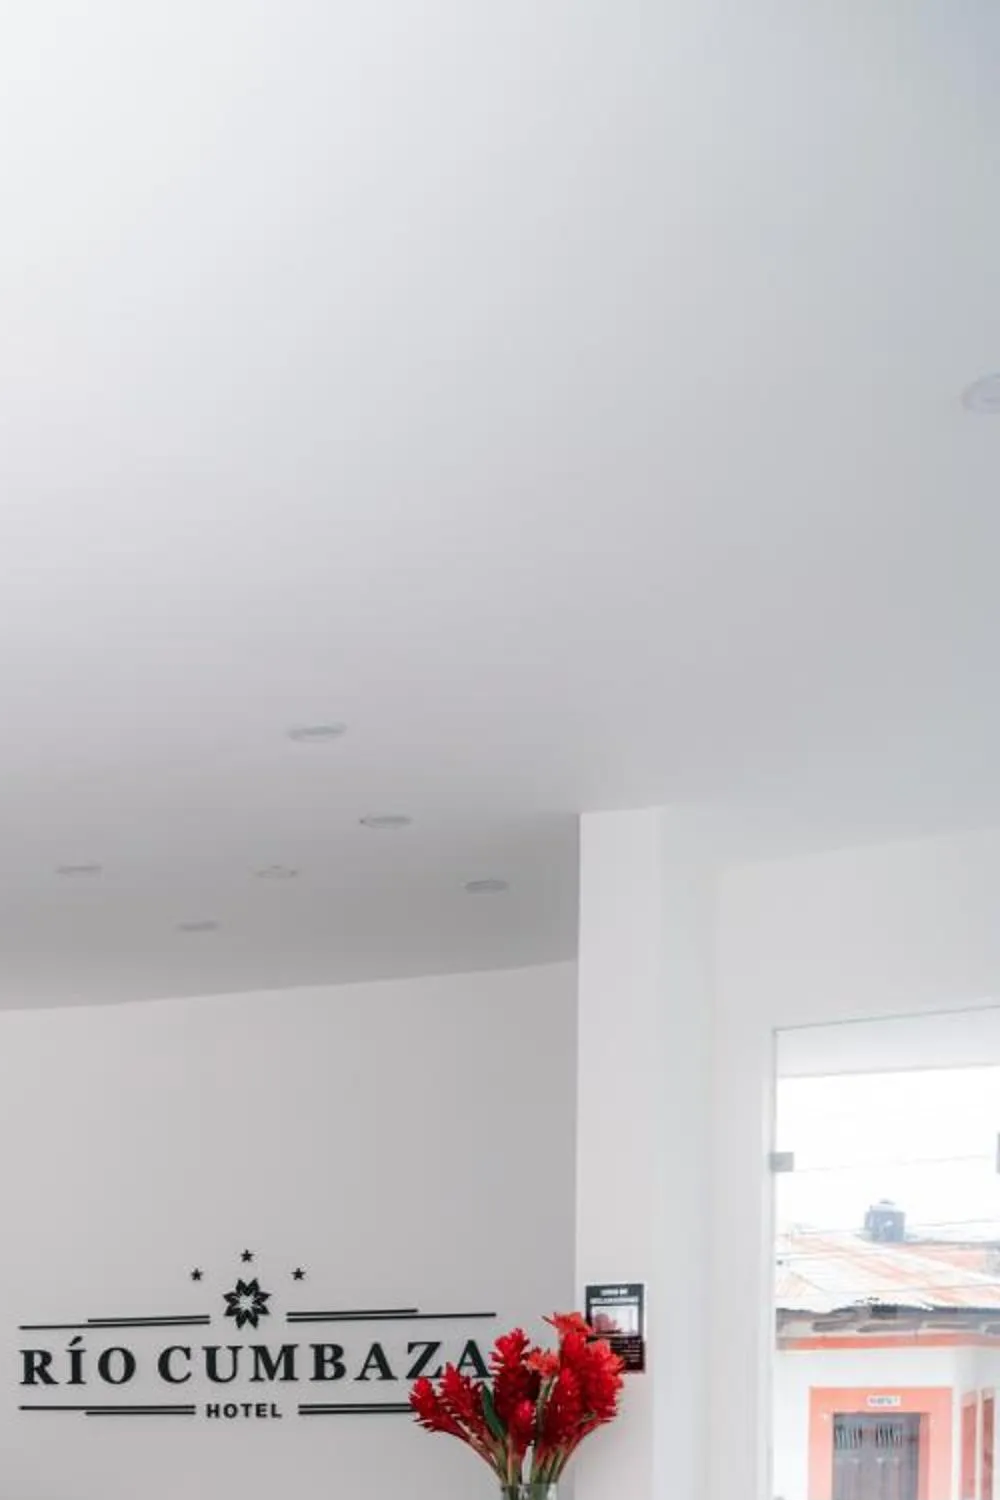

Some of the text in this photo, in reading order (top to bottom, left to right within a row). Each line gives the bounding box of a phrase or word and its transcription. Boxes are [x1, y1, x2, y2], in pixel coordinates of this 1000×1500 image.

[19, 1335, 493, 1385] RÍO CUMBAZA
[206, 1403, 283, 1419] HOTEL
